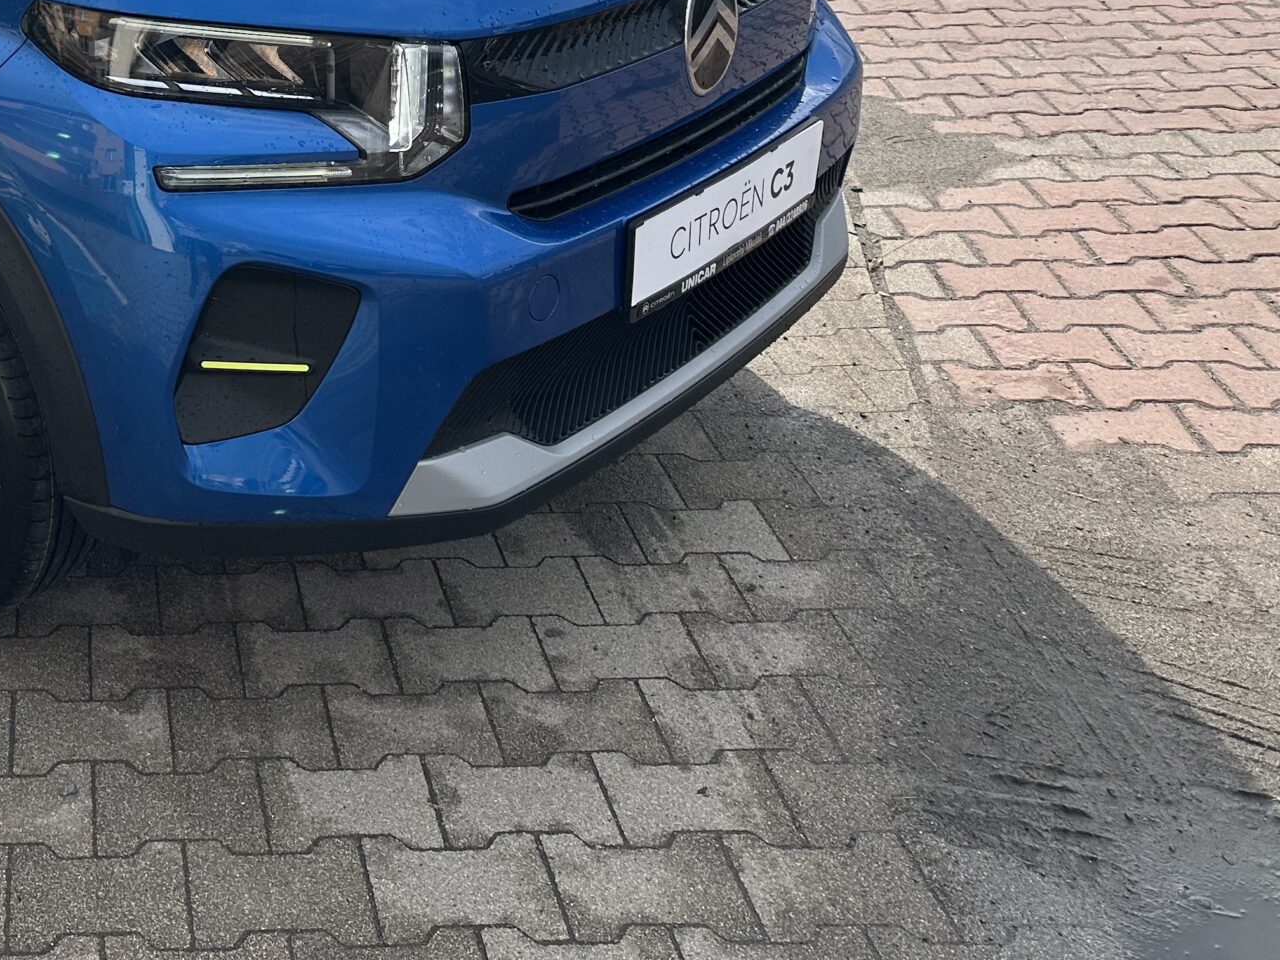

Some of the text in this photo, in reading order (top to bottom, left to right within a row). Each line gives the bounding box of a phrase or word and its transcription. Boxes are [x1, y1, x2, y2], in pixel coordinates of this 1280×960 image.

[670, 160, 795, 259] CITROËN C3
[681, 262, 716, 293] UNICAR
